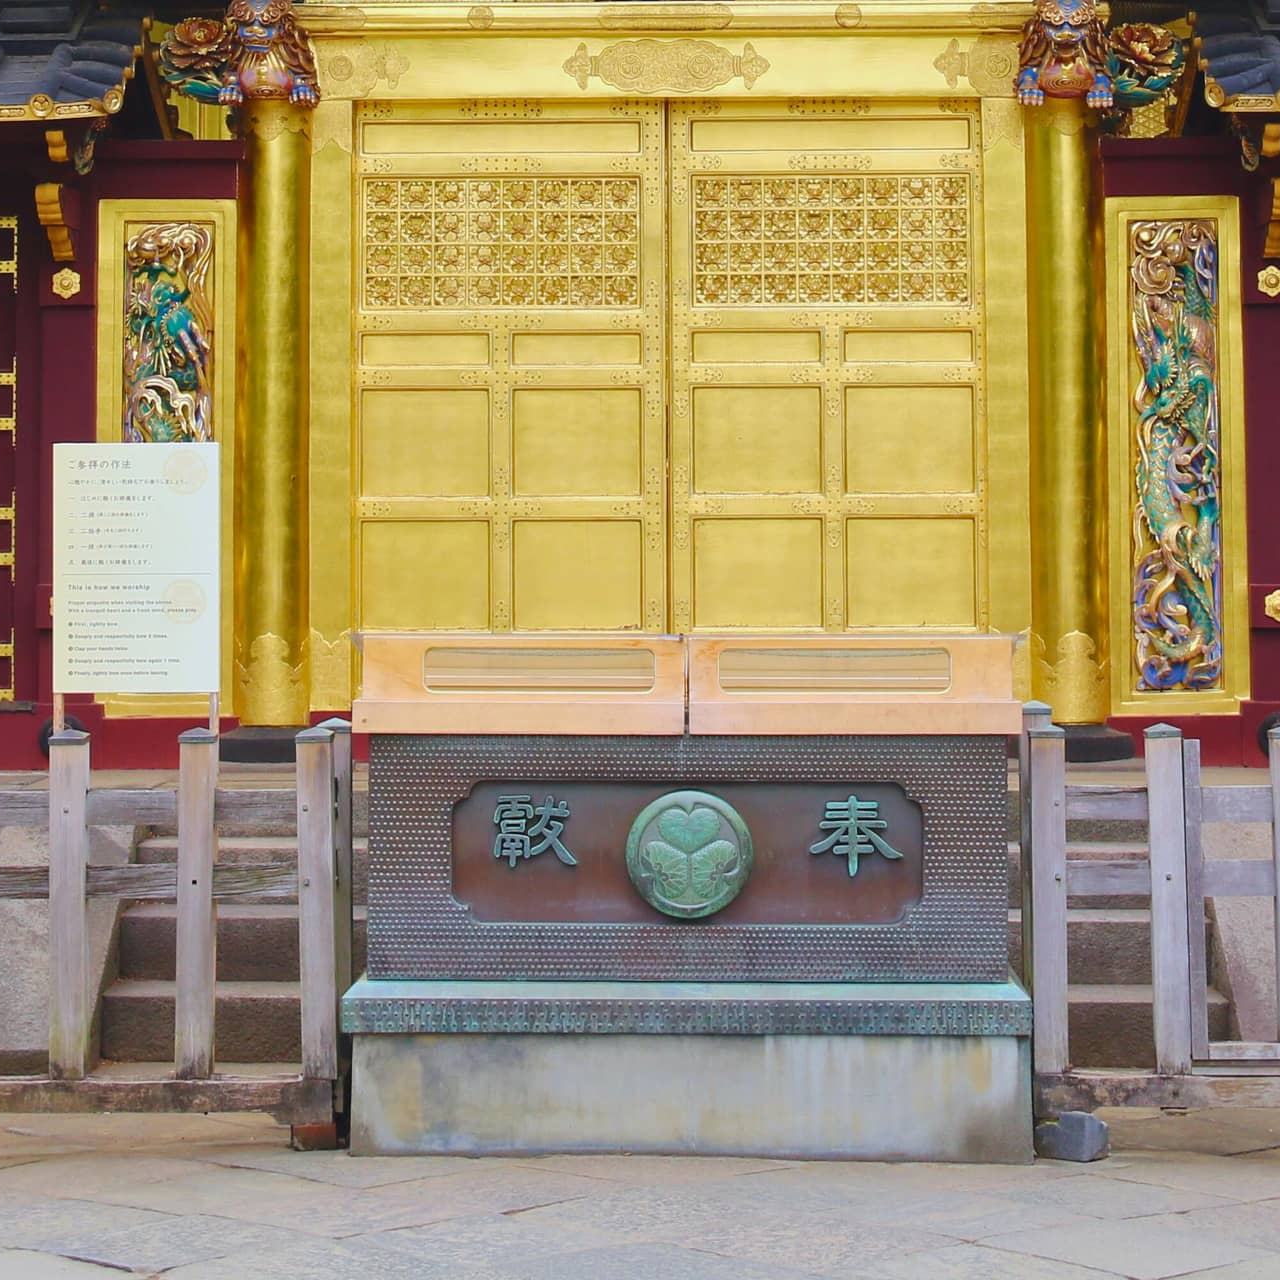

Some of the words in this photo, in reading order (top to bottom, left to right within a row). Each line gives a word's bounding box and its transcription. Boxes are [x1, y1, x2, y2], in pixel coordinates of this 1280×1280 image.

[68, 459, 132, 470] ご参拝の作法
[68, 583, 82, 592] This
[85, 583, 91, 592] is
[94, 583, 108, 592] how
[110, 583, 120, 592] we
[122, 583, 150, 593] worship
[810, 795, 904, 876] 奉
